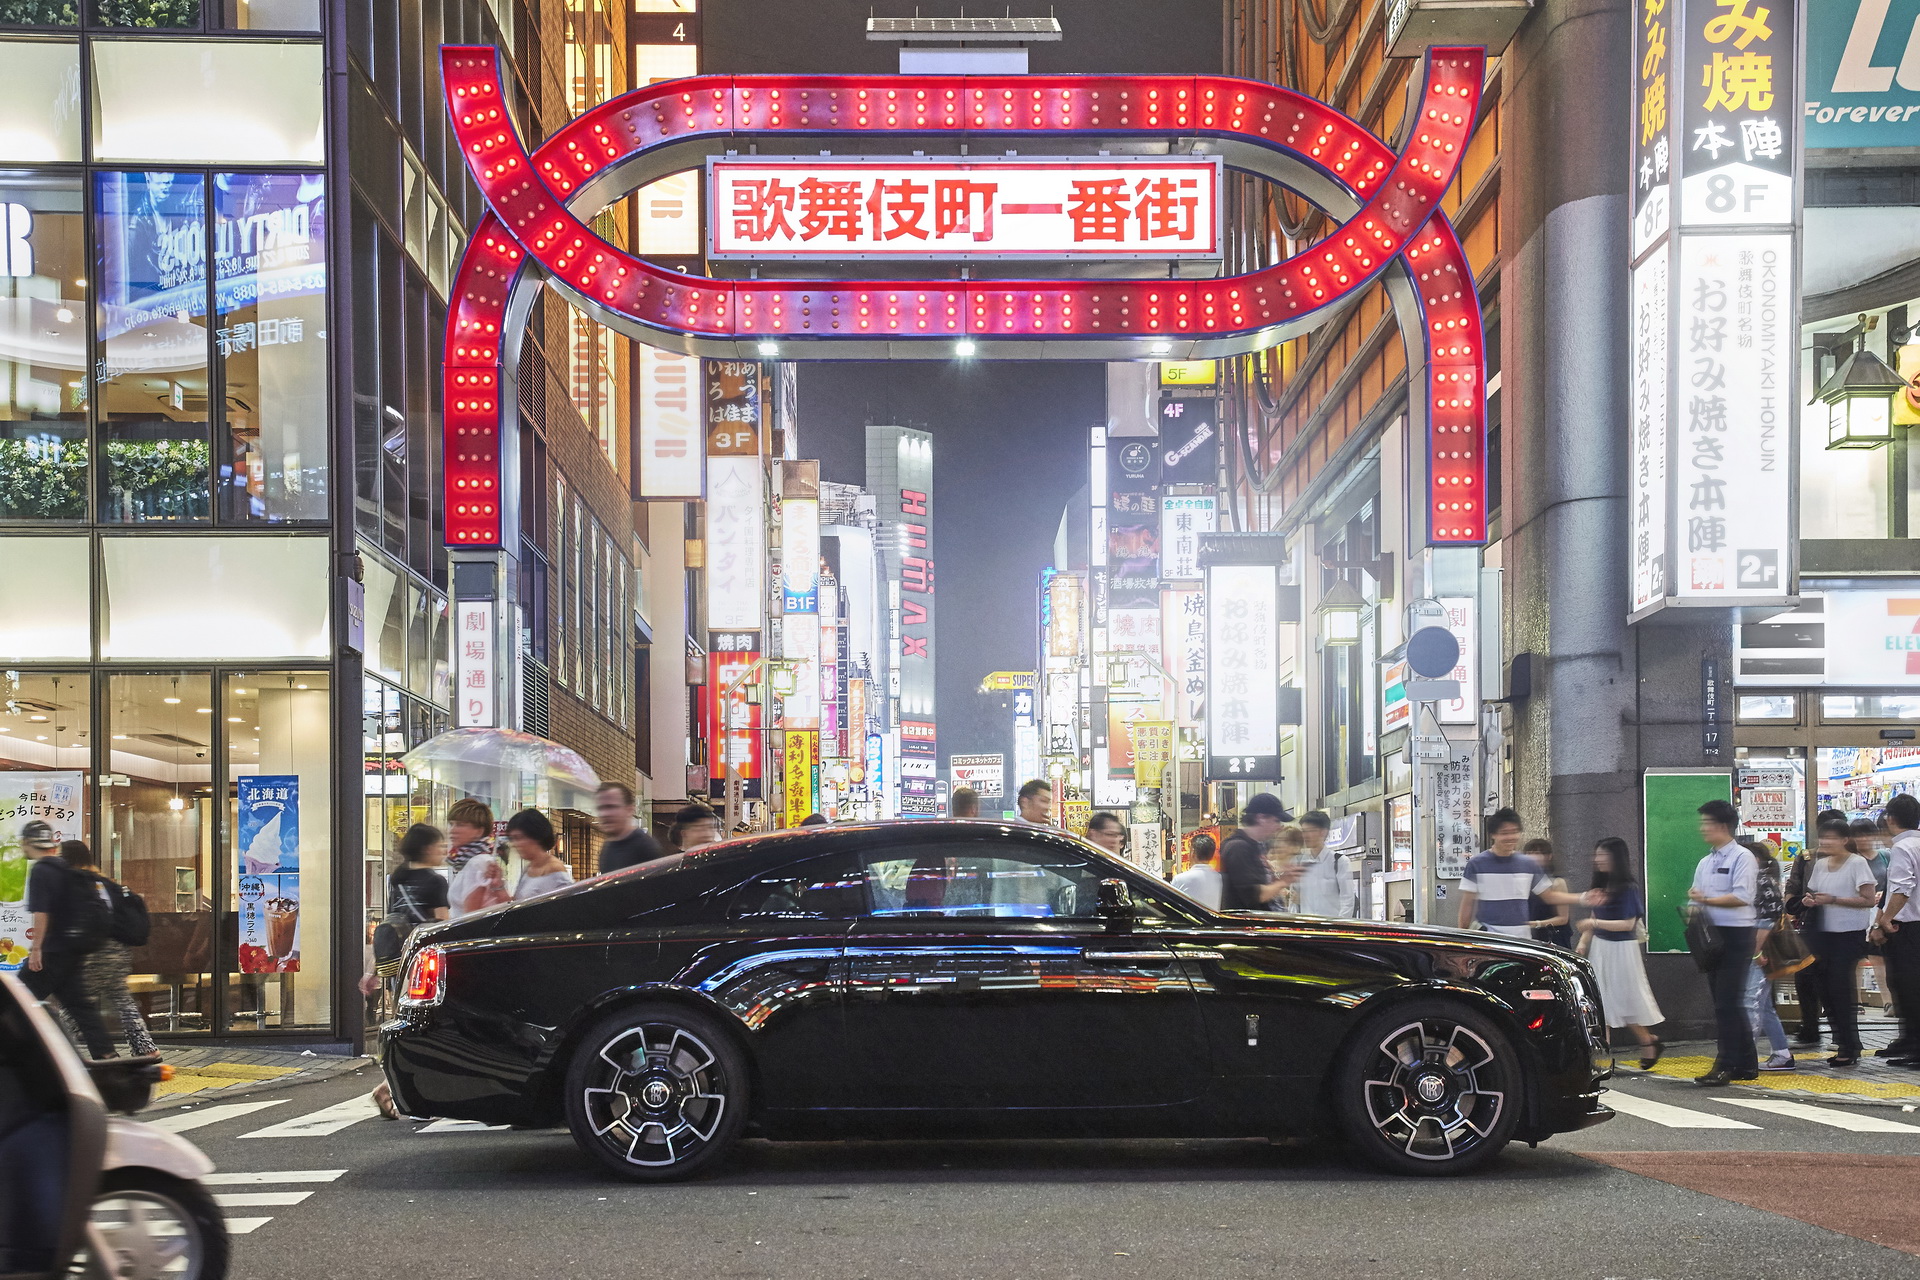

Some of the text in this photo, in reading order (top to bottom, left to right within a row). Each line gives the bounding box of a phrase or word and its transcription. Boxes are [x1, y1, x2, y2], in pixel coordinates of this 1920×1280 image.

[673, 22, 685, 41] 4
[1693, 117, 1782, 161] 本陣
[1705, 174, 1768, 213] 8F
[731, 178, 1198, 242] 歌舞伎町一番街
[1168, 368, 1187, 380] 5F
[1163, 403, 1184, 418] 4F
[1688, 278, 1728, 554] お好み焼き本陣
[716, 432, 751, 448] 3F
[1741, 556, 1776, 584] 2F
[787, 597, 816, 610] B1F
[717, 634, 752, 650] 焼肉
[465, 611, 486, 717] 劇場通り
[1706, 733, 1718, 742] 17
[1229, 757, 1256, 773] 2F
[19, 792, 47, 802] 今日は
[247, 787, 289, 800] 北海道
